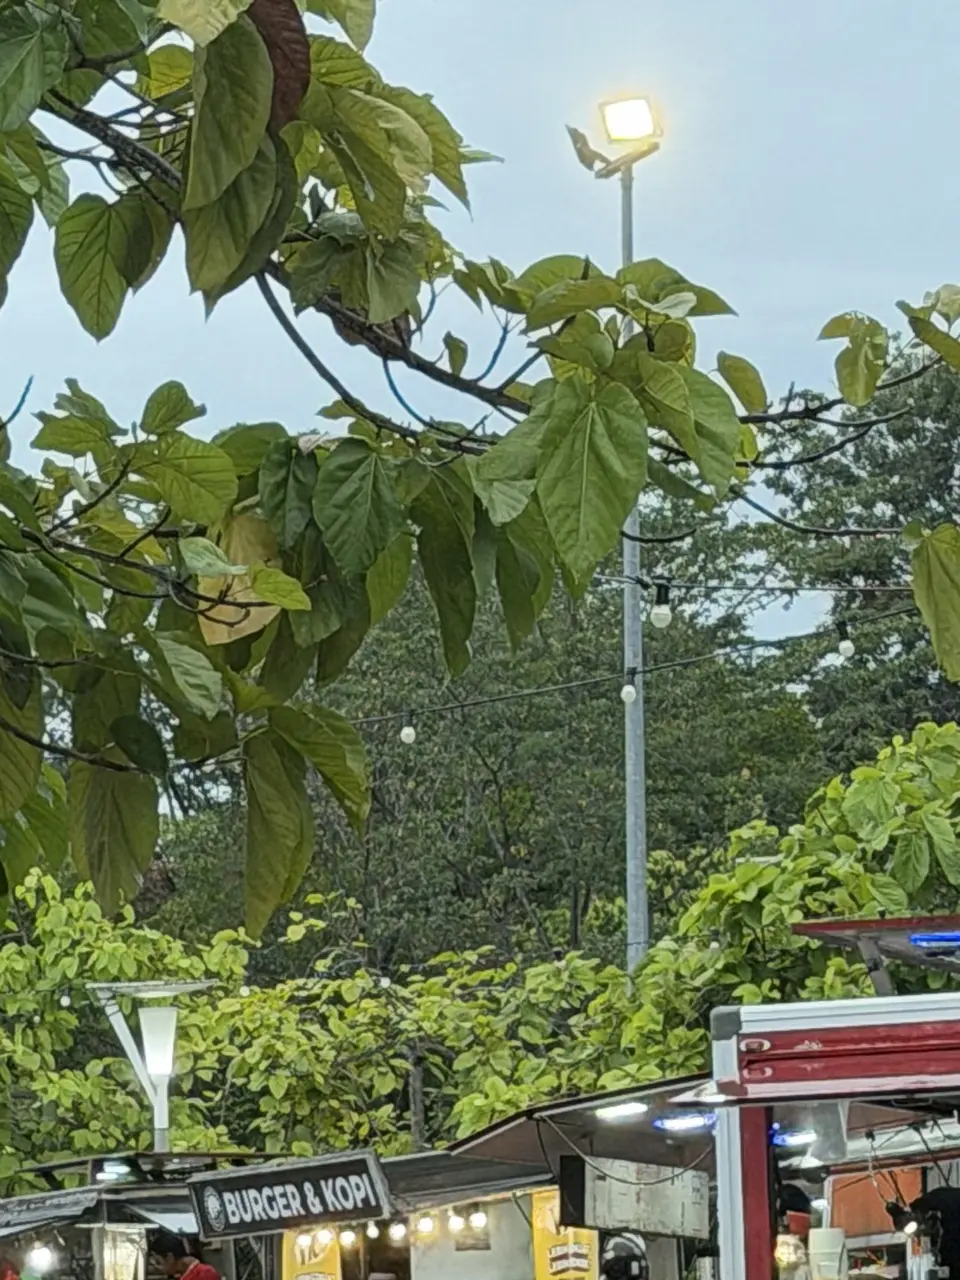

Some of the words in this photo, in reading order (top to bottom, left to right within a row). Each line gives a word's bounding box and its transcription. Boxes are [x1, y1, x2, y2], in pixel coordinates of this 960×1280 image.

[221, 1184, 306, 1224] BURGER
[303, 1181, 324, 1214] &
[320, 1173, 377, 1212] KOPI
